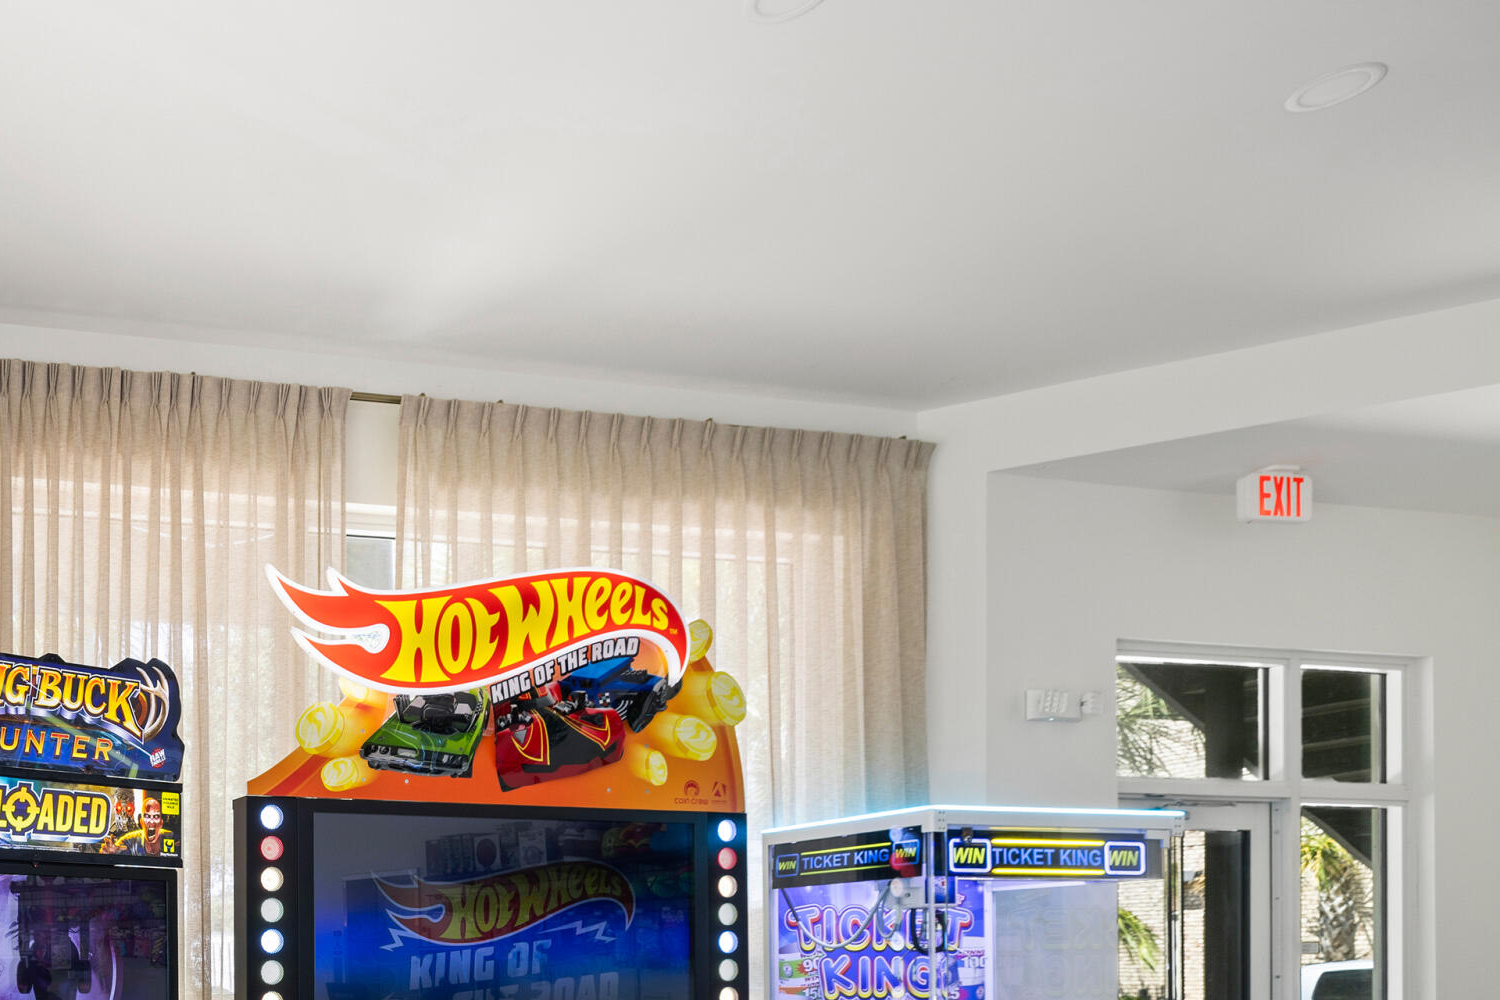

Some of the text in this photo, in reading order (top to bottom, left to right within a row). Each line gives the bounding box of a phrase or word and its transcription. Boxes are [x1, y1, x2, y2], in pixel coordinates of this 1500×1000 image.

[1259, 475, 1304, 517] EXIT
[491, 636, 640, 704] KING OF THE ROAD
[33, 668, 146, 738] BUCK
[778, 847, 916, 871] WIN TICKET KING WIN
[953, 848, 1139, 866] WIN TICKET KING WIN
[410, 938, 552, 991] KING OF
